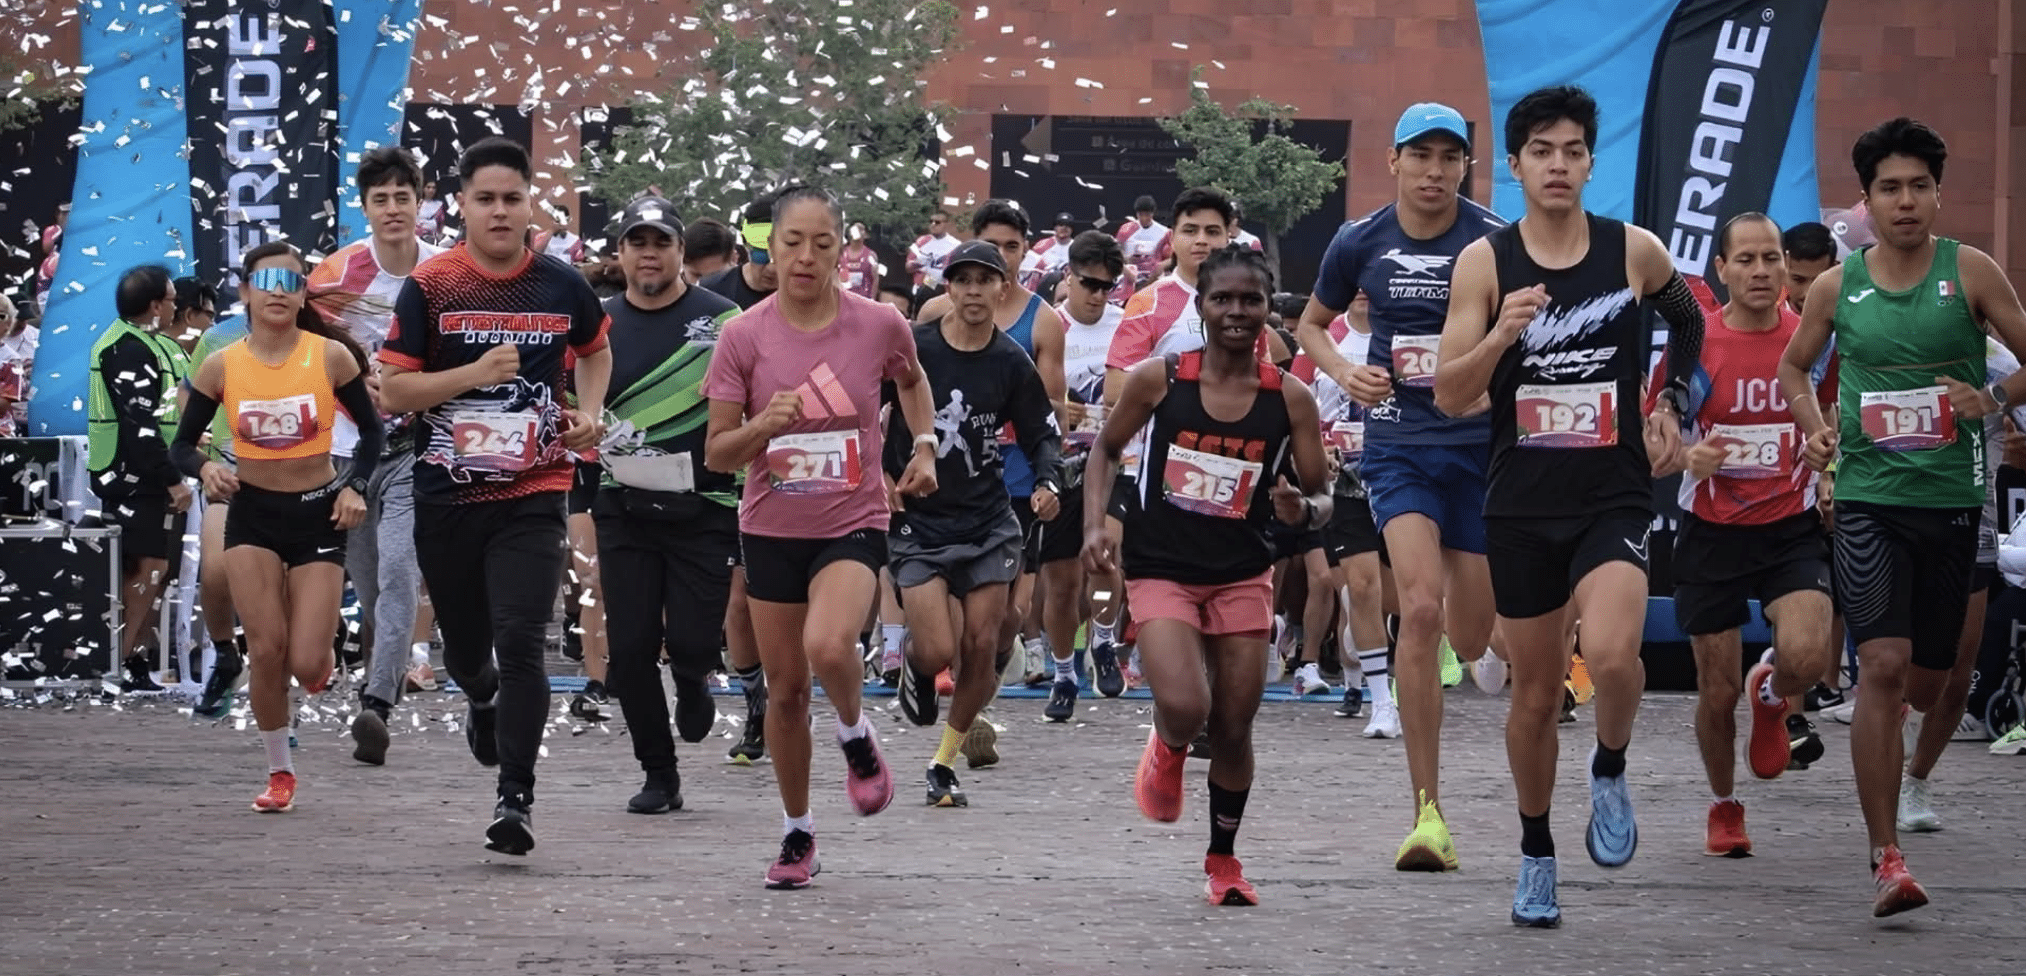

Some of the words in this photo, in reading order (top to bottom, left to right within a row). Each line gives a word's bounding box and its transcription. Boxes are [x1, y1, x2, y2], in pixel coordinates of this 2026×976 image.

[226, 13, 281, 270] ERADE
[1669, 19, 1771, 277] ERADE
[1388, 286, 1450, 299] TEAM
[1400, 351, 1438, 374] 20
[1521, 346, 1618, 367] NIKE
[247, 413, 299, 436] 148
[1536, 403, 1597, 431] 192
[1881, 407, 1932, 435] 191
[787, 451, 841, 478] 271
[1723, 442, 1780, 466] 228
[1971, 430, 1984, 486] MEX
[1182, 471, 1238, 502] 215
